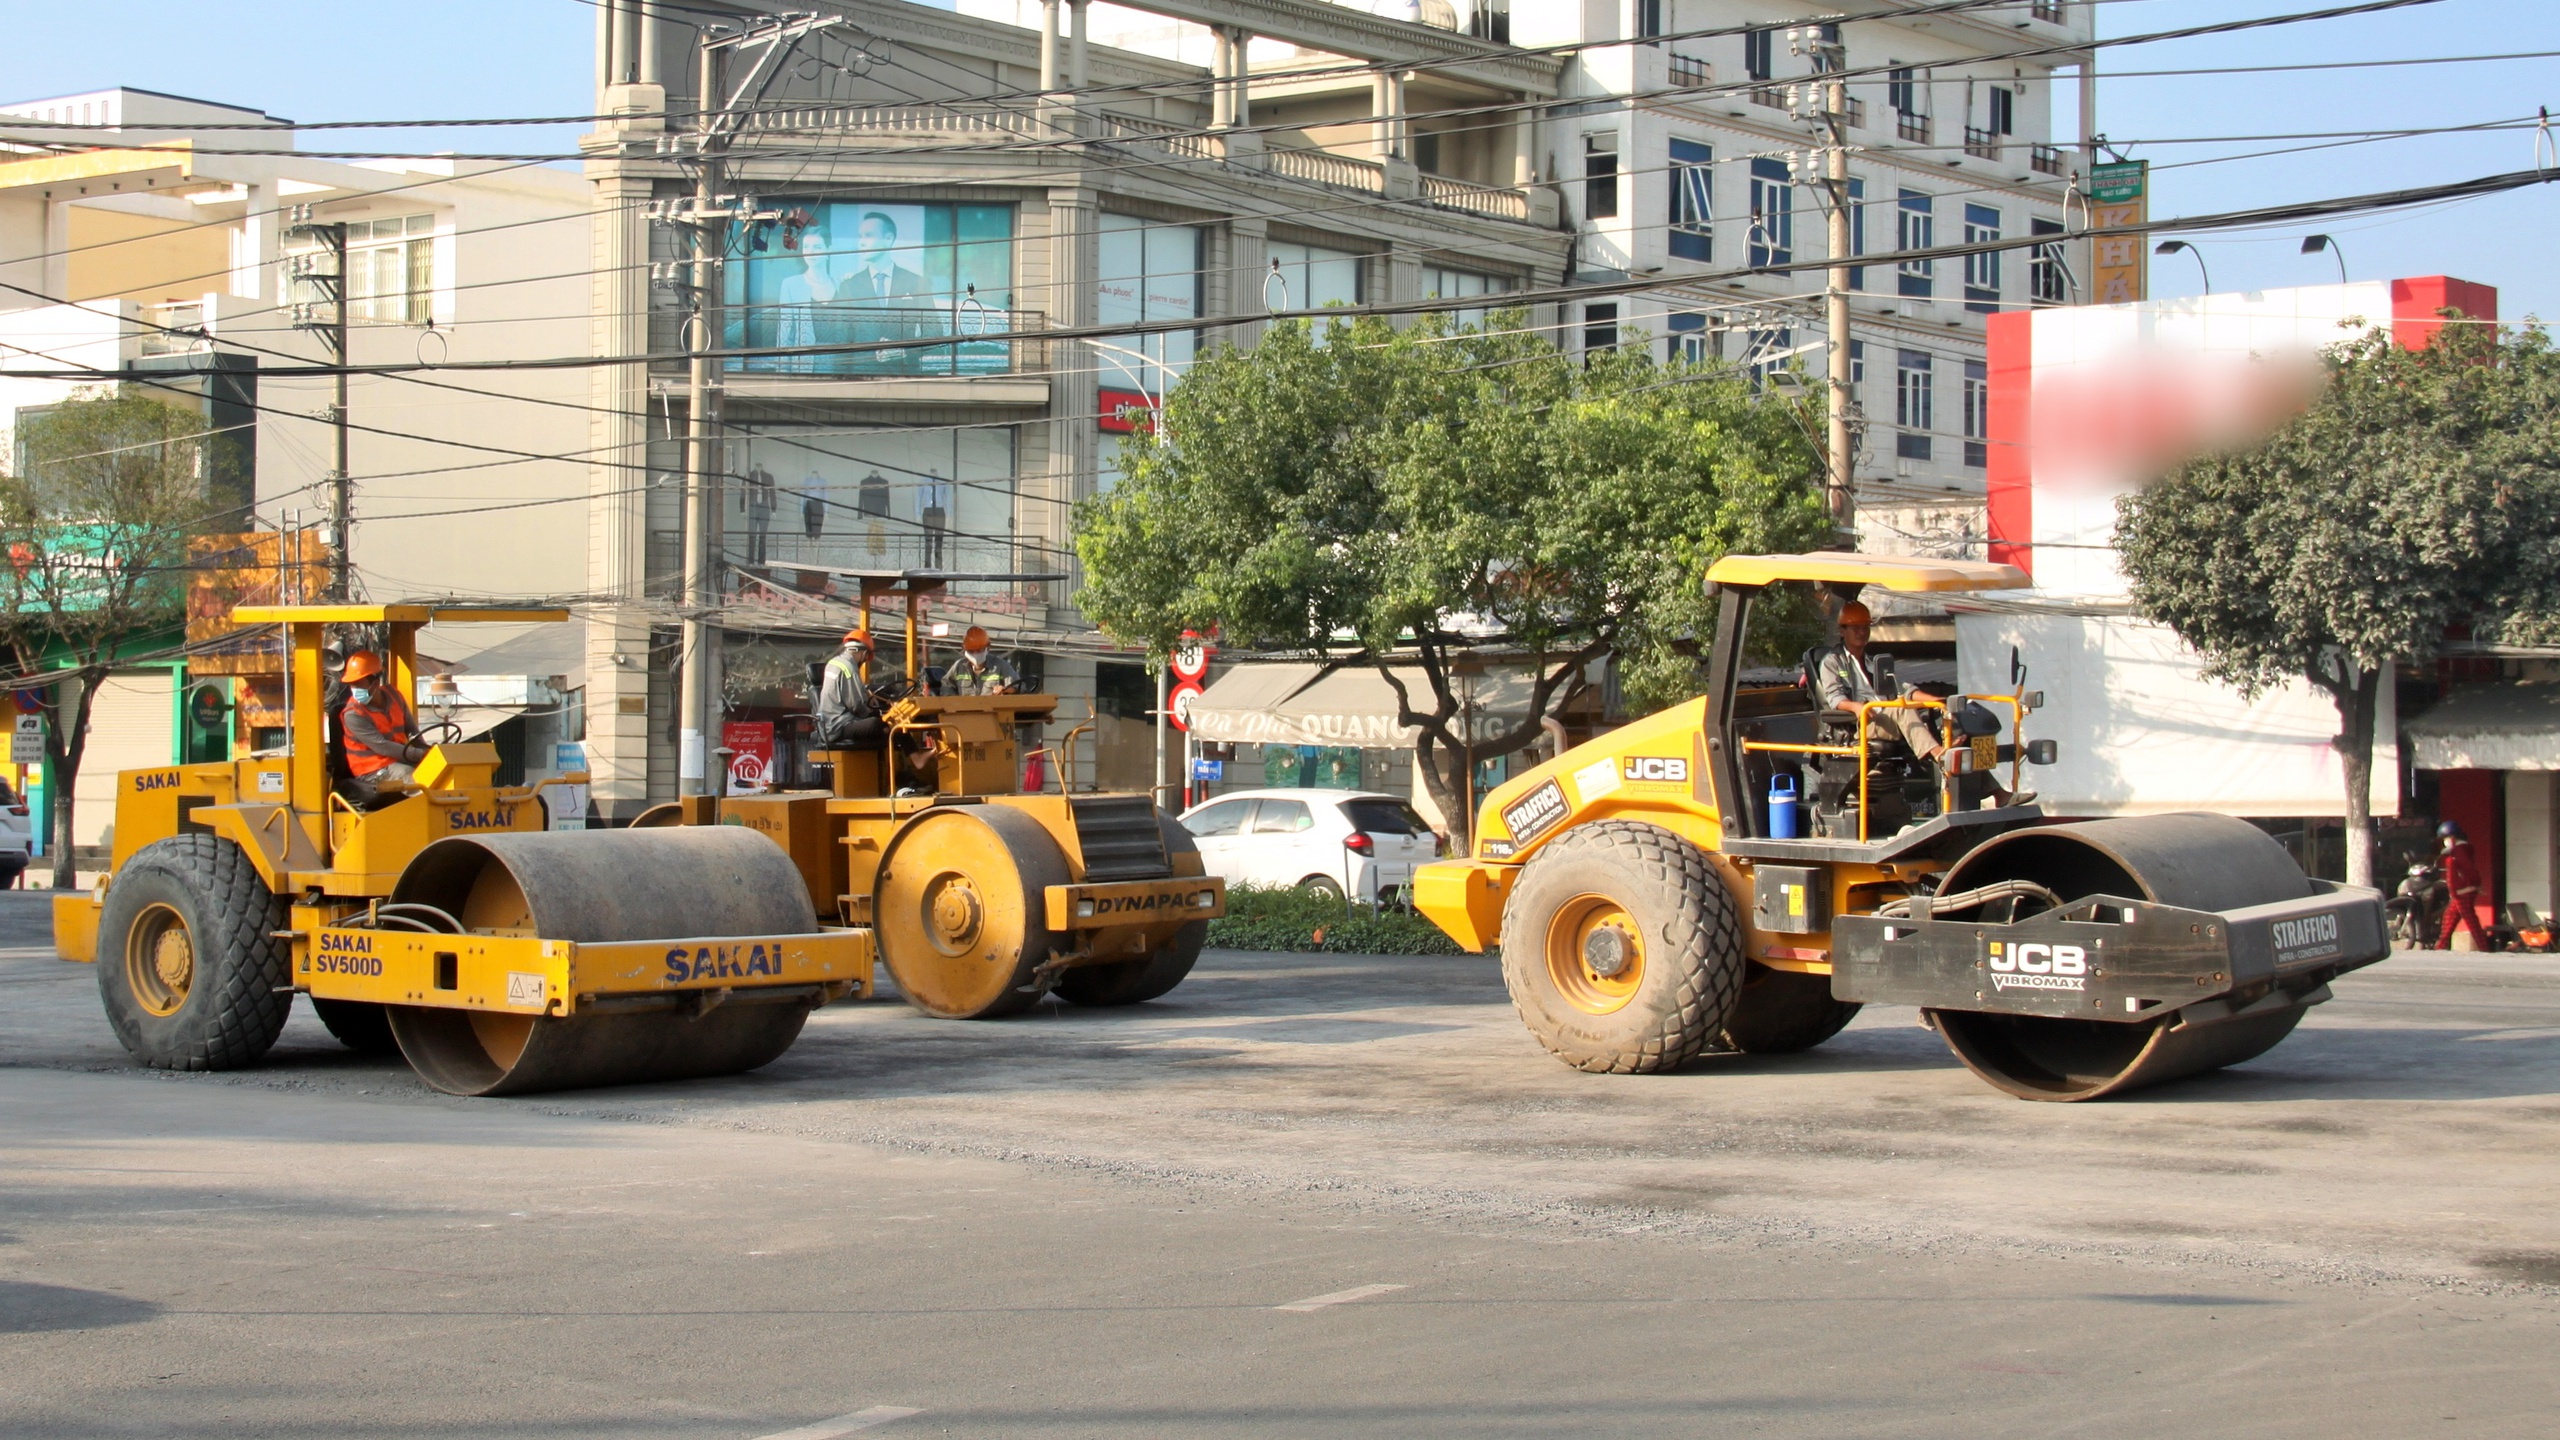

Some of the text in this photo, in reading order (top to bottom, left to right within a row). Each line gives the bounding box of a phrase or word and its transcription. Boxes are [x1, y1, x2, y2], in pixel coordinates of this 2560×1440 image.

[943, 591, 1028, 614] cardin
[1301, 714, 1412, 743] QUANG
[1626, 759, 1687, 780] JCB
[135, 771, 181, 792] SAKAI
[450, 809, 513, 829] SAKAI
[1507, 784, 1561, 833] STRAFFICO
[1097, 893, 1197, 914] DYNAPAC
[2273, 914, 2337, 949] STRAFFICO
[321, 933, 372, 953] SAKAI
[317, 954, 383, 976] SV500D
[1990, 943, 2086, 975] JCB
[1993, 974, 2083, 990] VIBROMAX
